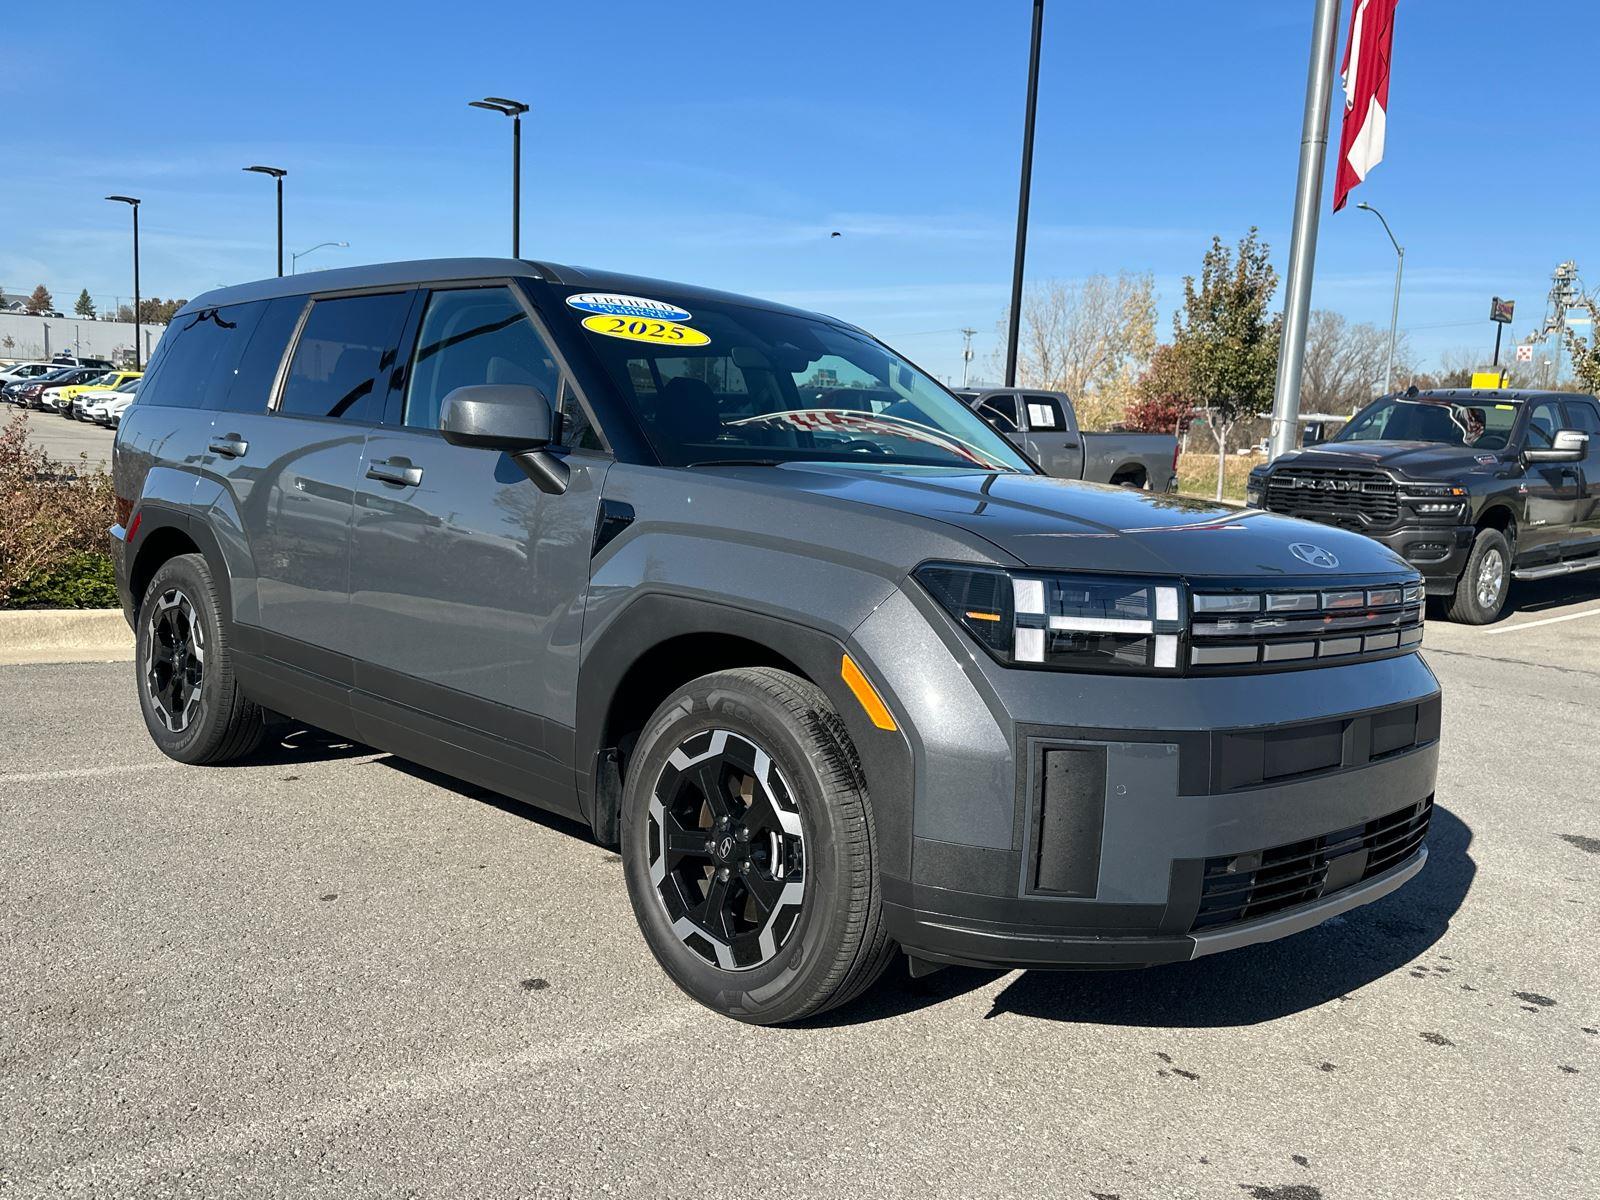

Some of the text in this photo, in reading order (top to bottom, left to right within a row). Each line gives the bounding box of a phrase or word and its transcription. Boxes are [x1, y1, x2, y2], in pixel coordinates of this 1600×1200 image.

[580, 296, 674, 311] CERTIFIED
[589, 303, 675, 316] PRE-OWNED
[605, 308, 667, 319] VEHICLE
[607, 319, 686, 340] 2025
[1296, 478, 1359, 492] RAM
